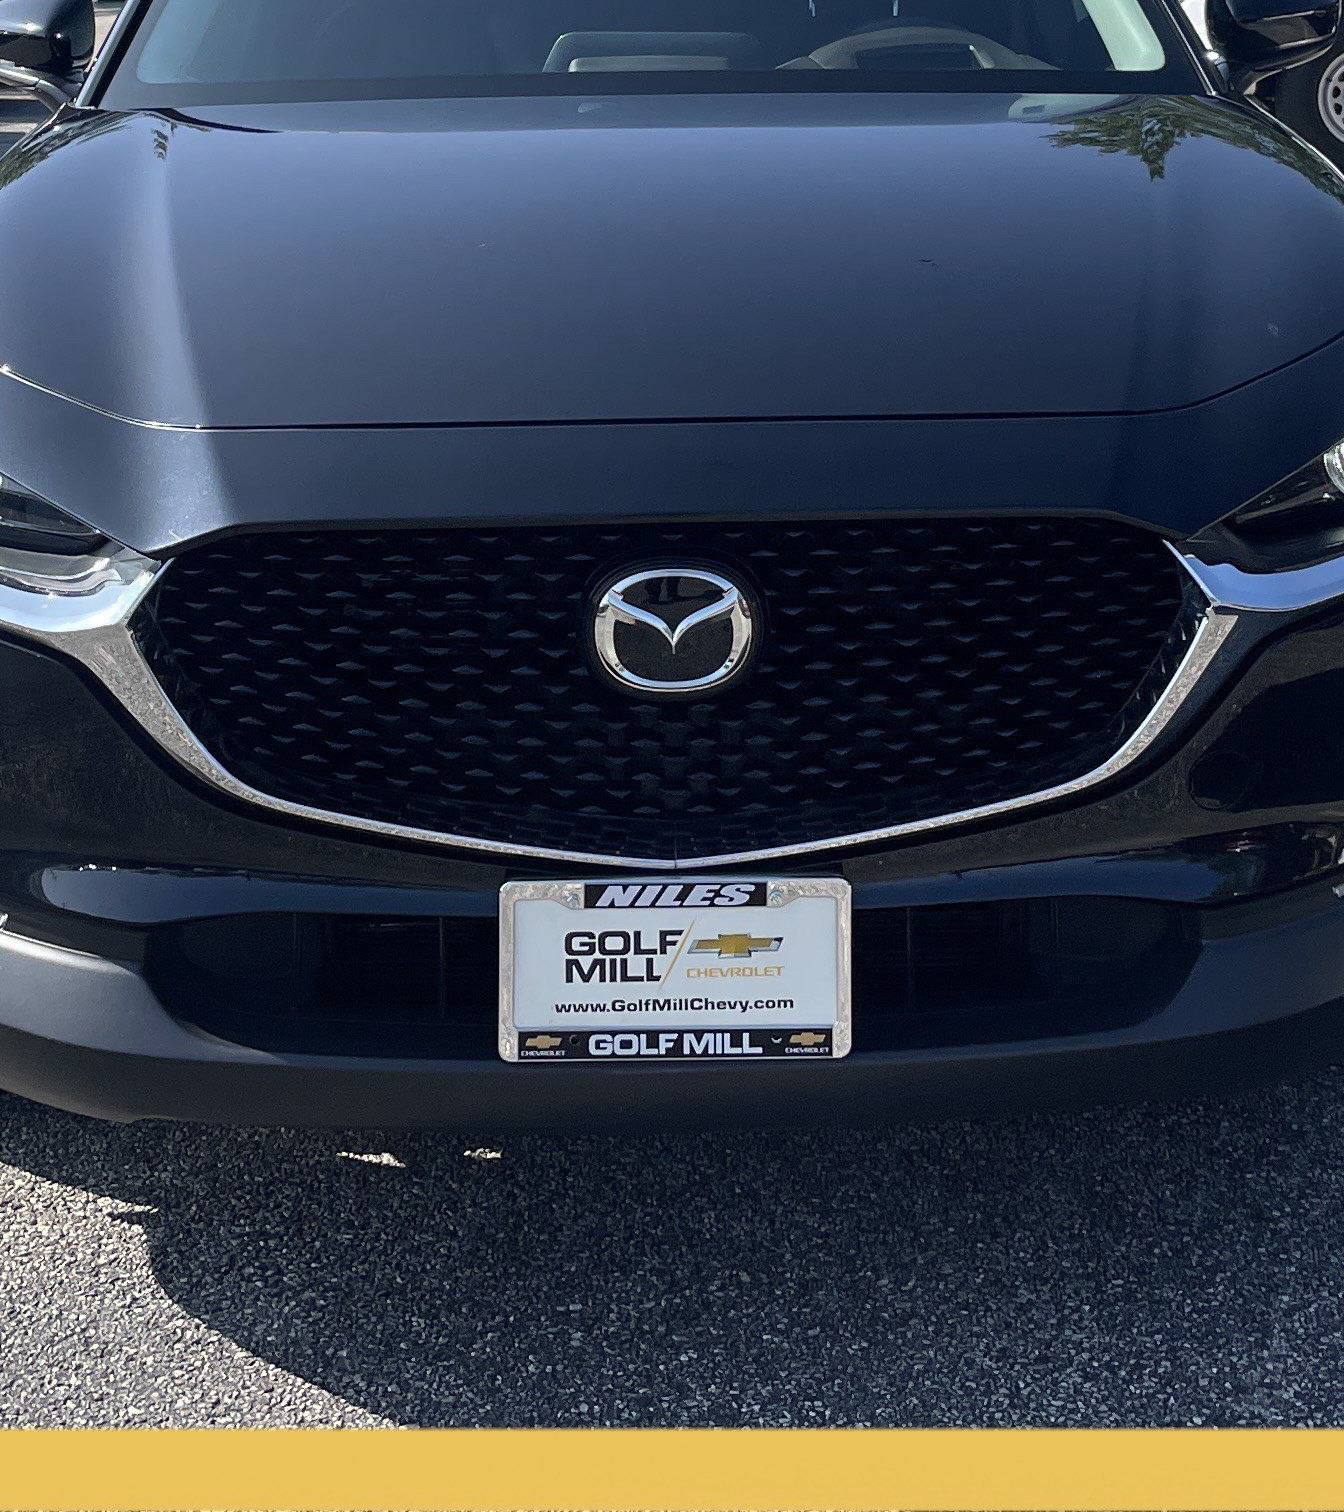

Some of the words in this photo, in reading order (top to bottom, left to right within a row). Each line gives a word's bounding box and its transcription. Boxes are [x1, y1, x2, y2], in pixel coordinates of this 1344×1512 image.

[595, 883, 755, 907] NILES
[564, 929, 685, 956] GOLF
[565, 958, 662, 983] MILL
[686, 965, 785, 979] CHEVROLET
[555, 997, 795, 1014] www.GolfMillChevy.com
[588, 1033, 678, 1056] GOLF
[682, 1032, 763, 1055] MILL
